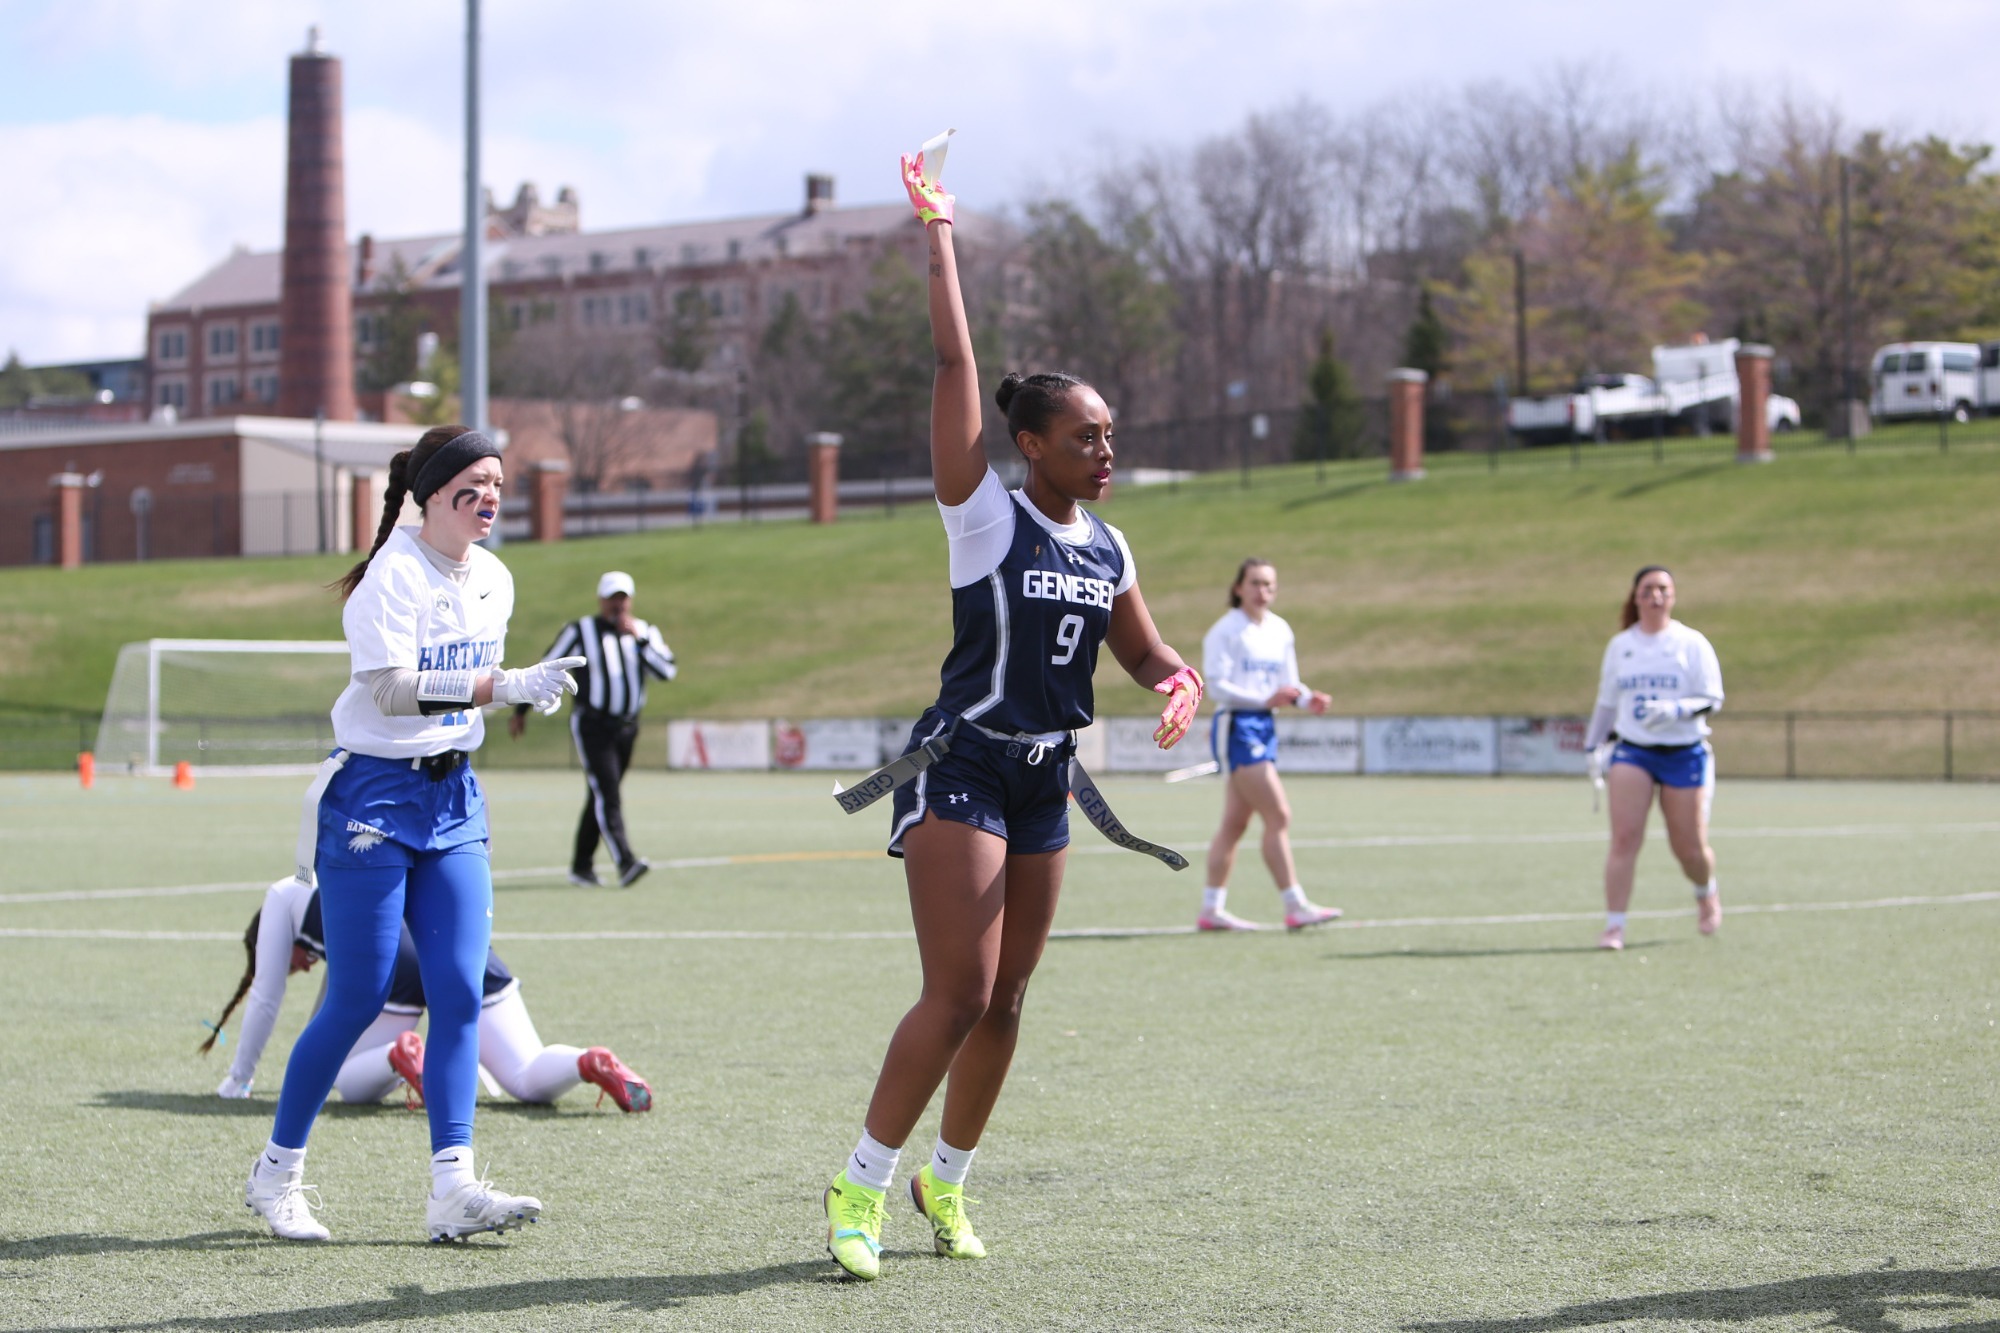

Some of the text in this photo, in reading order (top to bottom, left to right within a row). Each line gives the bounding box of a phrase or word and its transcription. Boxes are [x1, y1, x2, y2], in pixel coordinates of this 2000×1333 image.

[1023, 570, 1114, 611] GENESEO
[1051, 614, 1085, 665] 9
[1079, 787, 1153, 852] GENESEO
